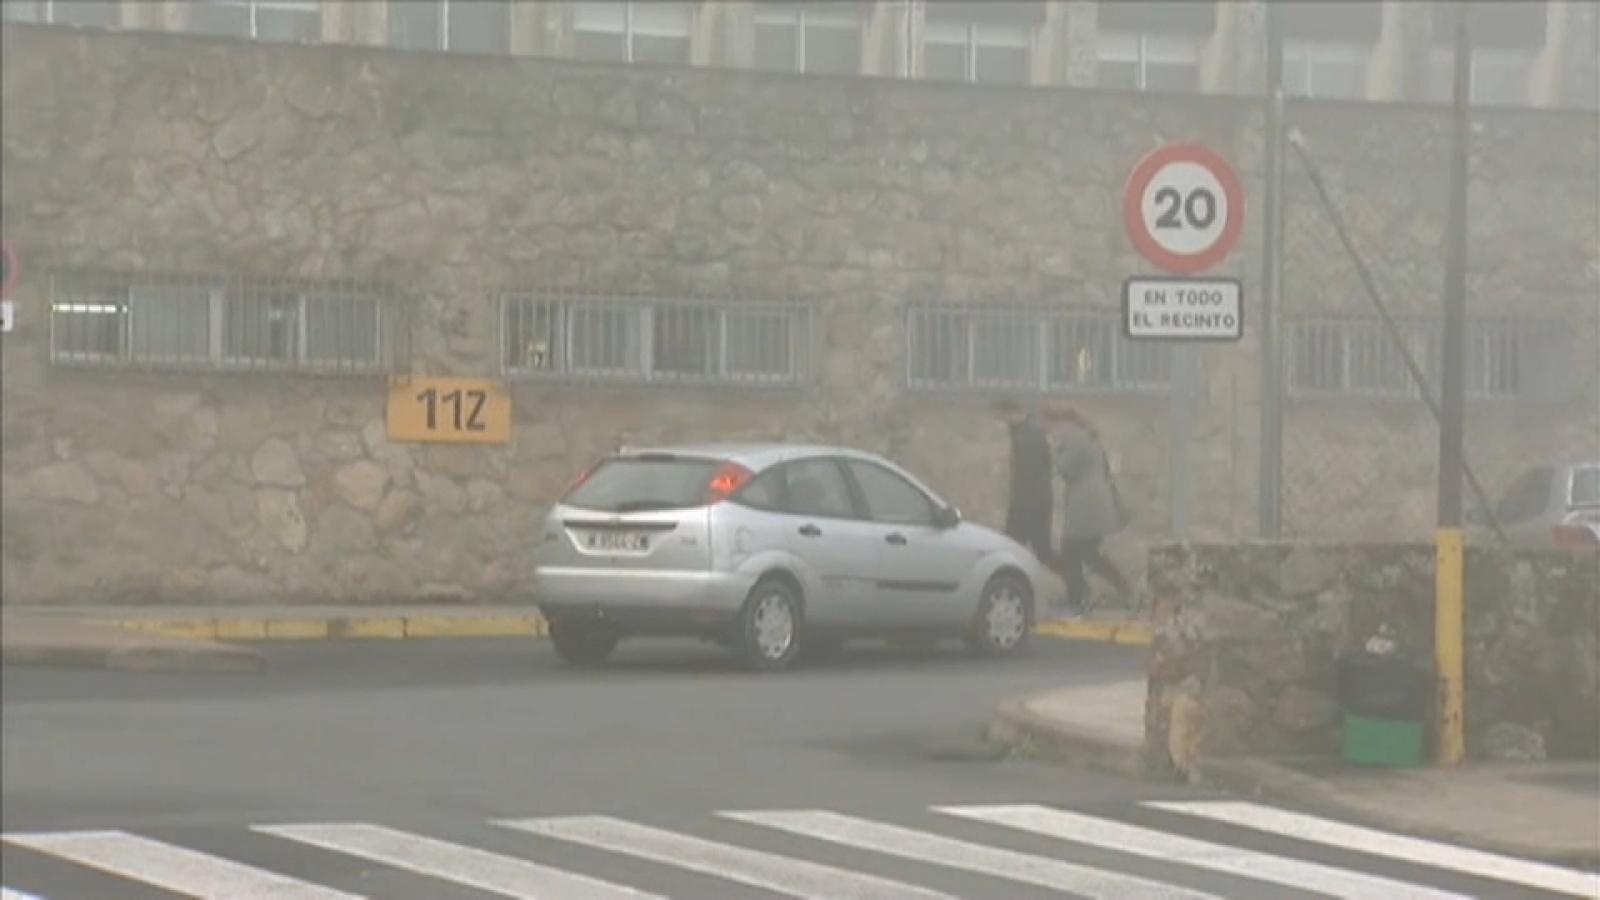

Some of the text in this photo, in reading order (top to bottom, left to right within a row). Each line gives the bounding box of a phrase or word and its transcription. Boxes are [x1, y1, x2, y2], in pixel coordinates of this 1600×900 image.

[1154, 186, 1216, 229] 20
[1144, 289, 1223, 306] EN TODO
[1132, 311, 1235, 329] EL RECINTO
